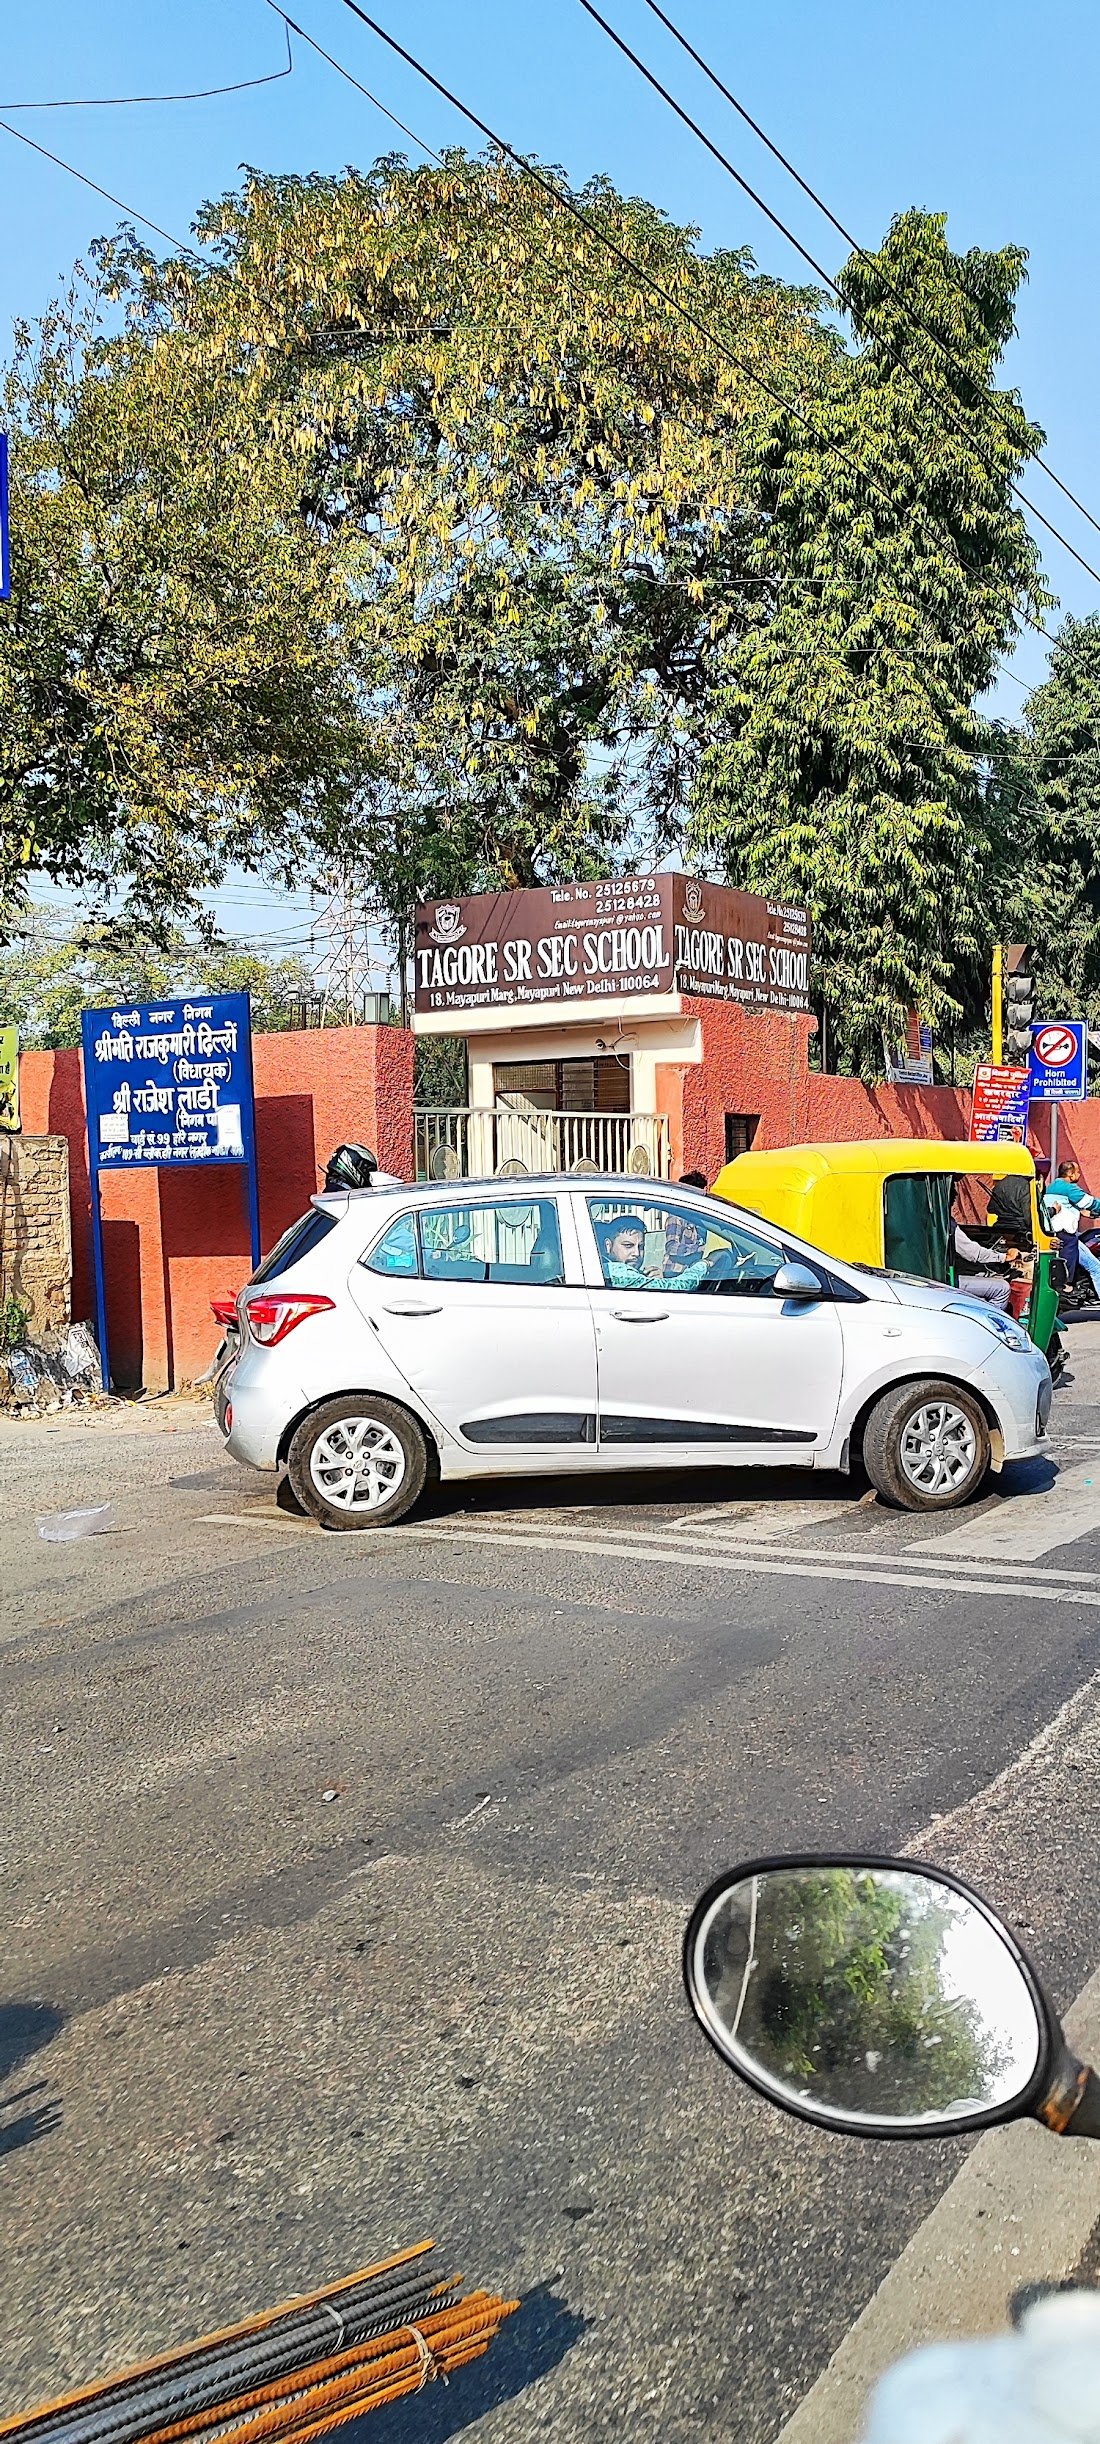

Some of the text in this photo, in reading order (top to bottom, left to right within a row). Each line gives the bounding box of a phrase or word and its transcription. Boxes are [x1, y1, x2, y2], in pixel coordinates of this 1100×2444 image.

[576, 887, 592, 900] No.
[595, 878, 656, 898] 25125679
[596, 894, 661, 914] 25128428
[417, 924, 670, 989] TAGORE SR SEC SCHOOL
[675, 924, 809, 991] TAGORE SR SEC SCHOOL
[446, 989, 491, 1008] Mayapuri
[517, 984, 561, 1002] Mayapuri
[562, 981, 584, 997] New
[586, 974, 660, 994] Delhi-110064
[756, 988, 769, 1003] New
[111, 1004, 213, 1029] दिल्ली नगर निगम
[95, 1030, 134, 1063] श्रीमति
[135, 1023, 197, 1064] राजकुमारी
[173, 1056, 232, 1083] (विधायक)
[1034, 1078, 1077, 1087] Prohibited
[1045, 1069, 1065, 1078] Horn
[113, 1082, 131, 1114] श्री
[132, 1080, 175, 1114] राजेश
